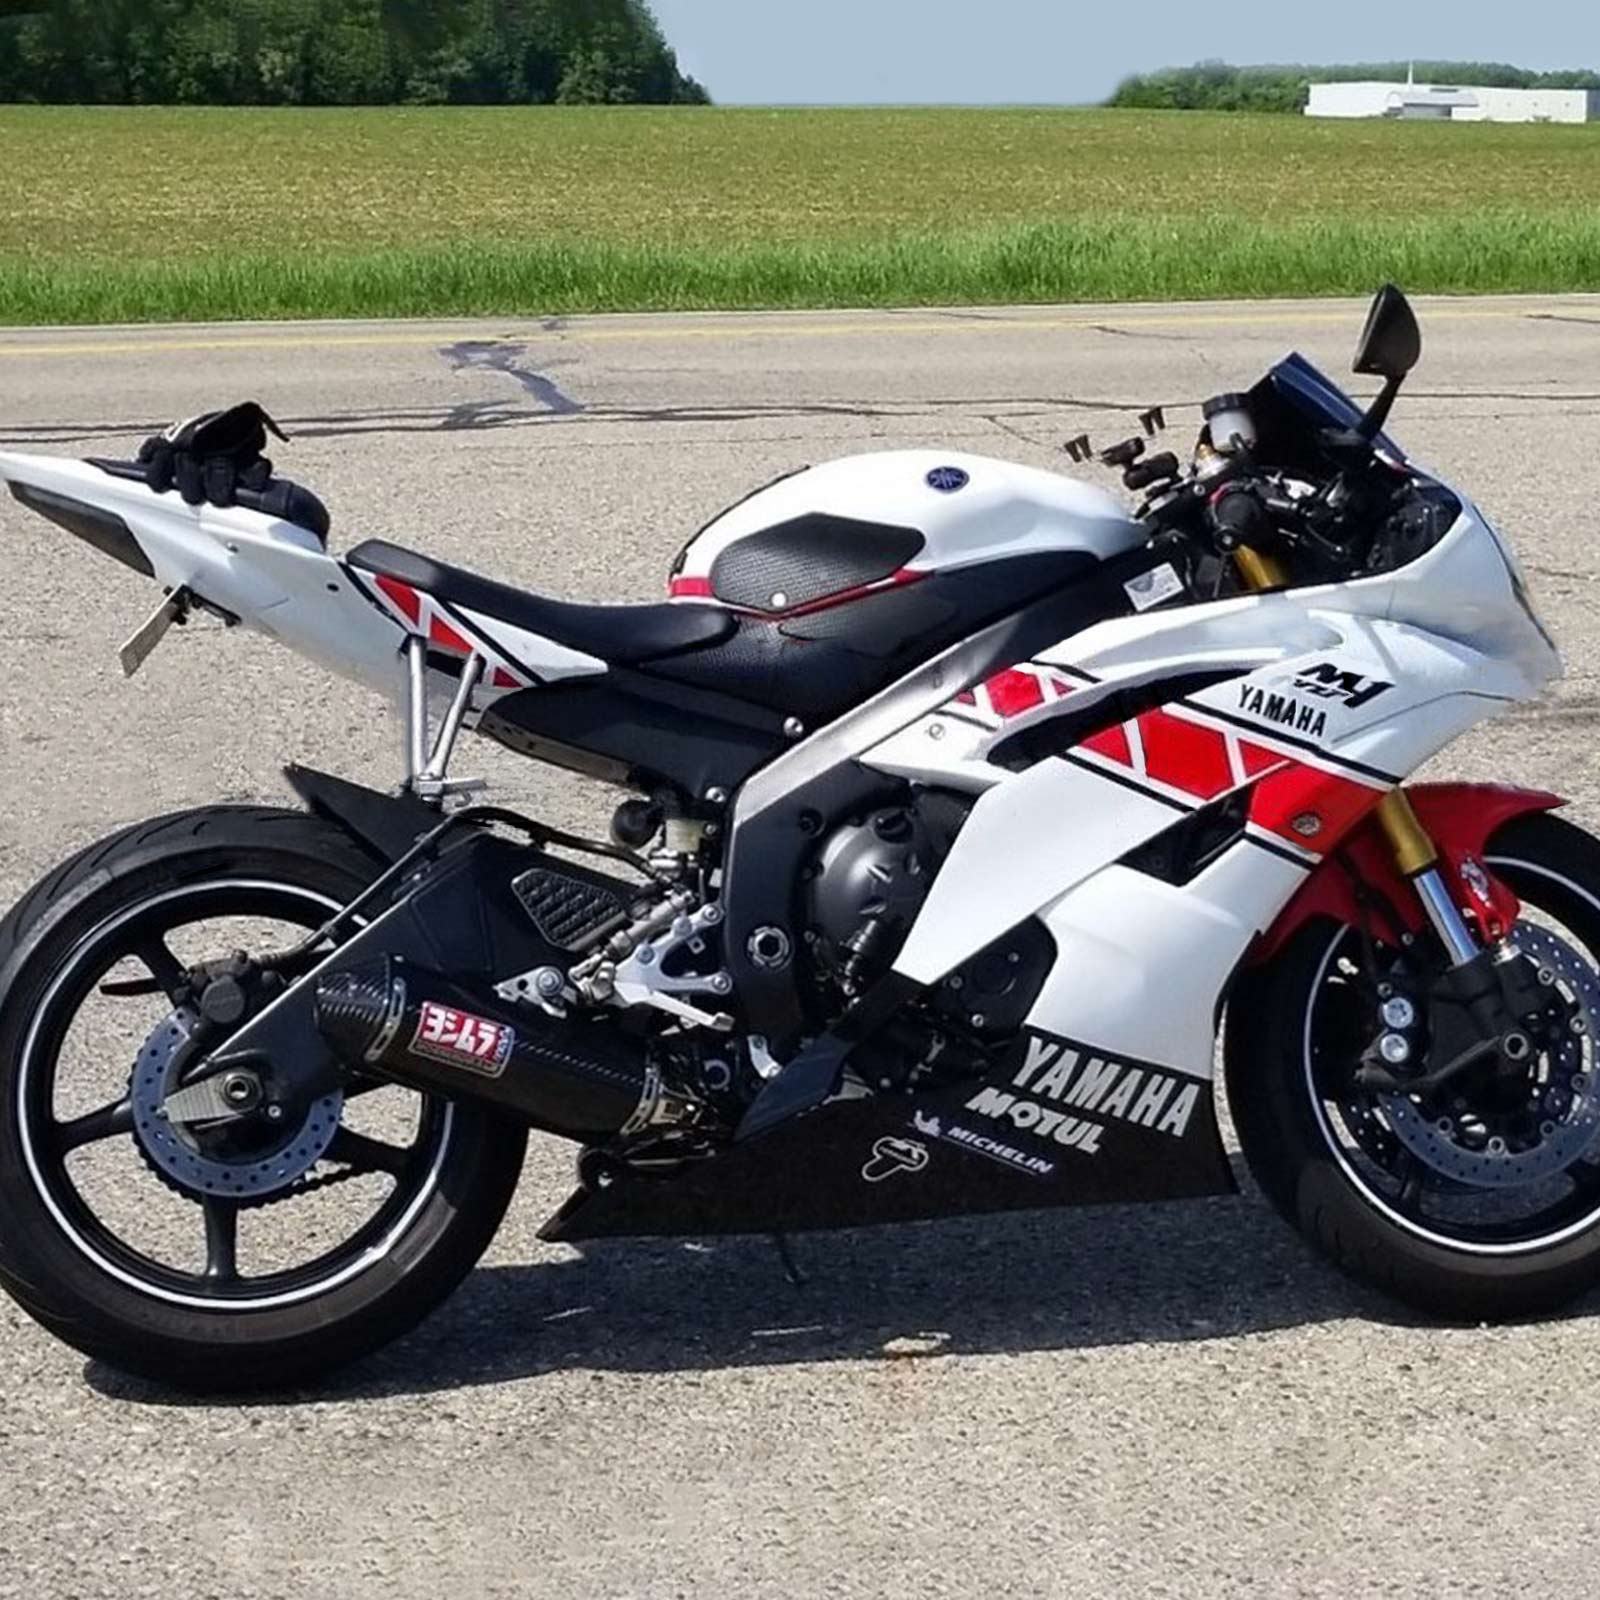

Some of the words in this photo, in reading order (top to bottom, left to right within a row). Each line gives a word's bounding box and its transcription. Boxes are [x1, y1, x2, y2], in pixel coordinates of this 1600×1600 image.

[1238, 683, 1327, 737] YAMAHA
[423, 1006, 496, 1056] ヨシムラ
[1012, 1036, 1200, 1137] YAMAHA
[965, 1087, 1104, 1154] MOTUL
[947, 1126, 1053, 1173] MICHELIN
